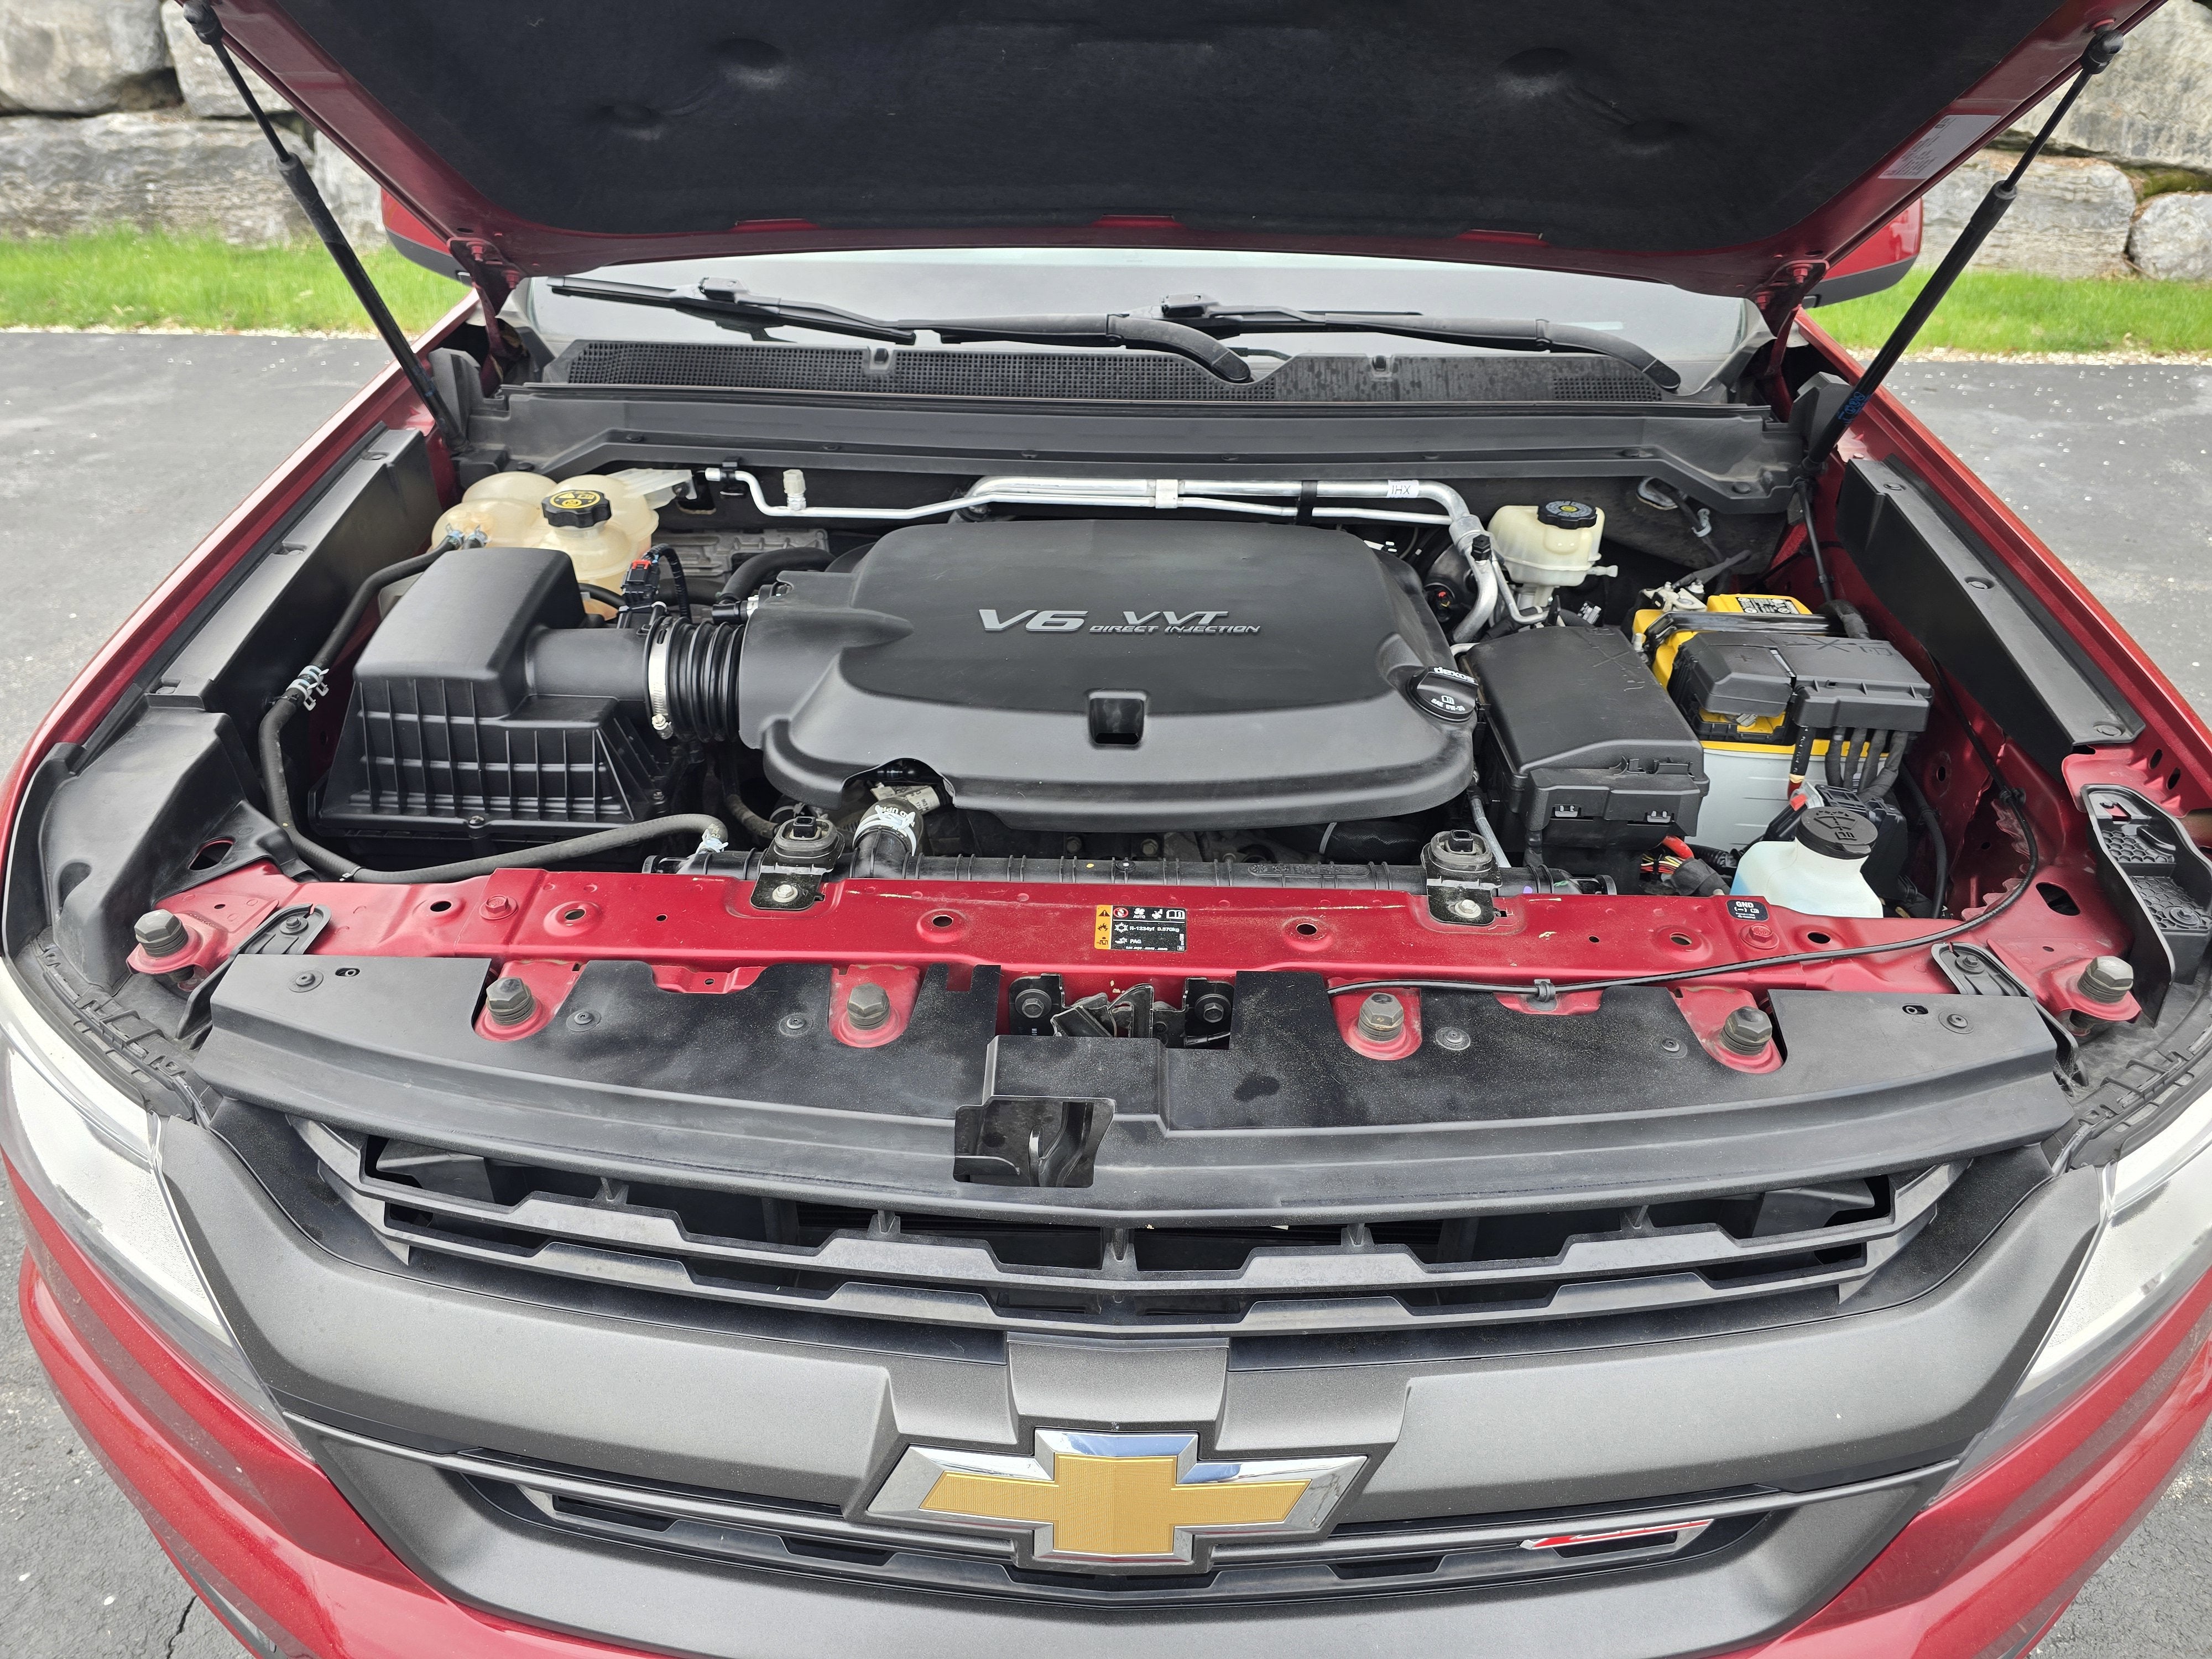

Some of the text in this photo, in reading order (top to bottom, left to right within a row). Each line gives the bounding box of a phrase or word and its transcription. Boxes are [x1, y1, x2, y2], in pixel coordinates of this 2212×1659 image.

[1391, 485, 1411, 495] IHX
[978, 609, 1089, 632] V6
[1123, 611, 1229, 625] VVT
[1433, 666, 1475, 683] dexos
